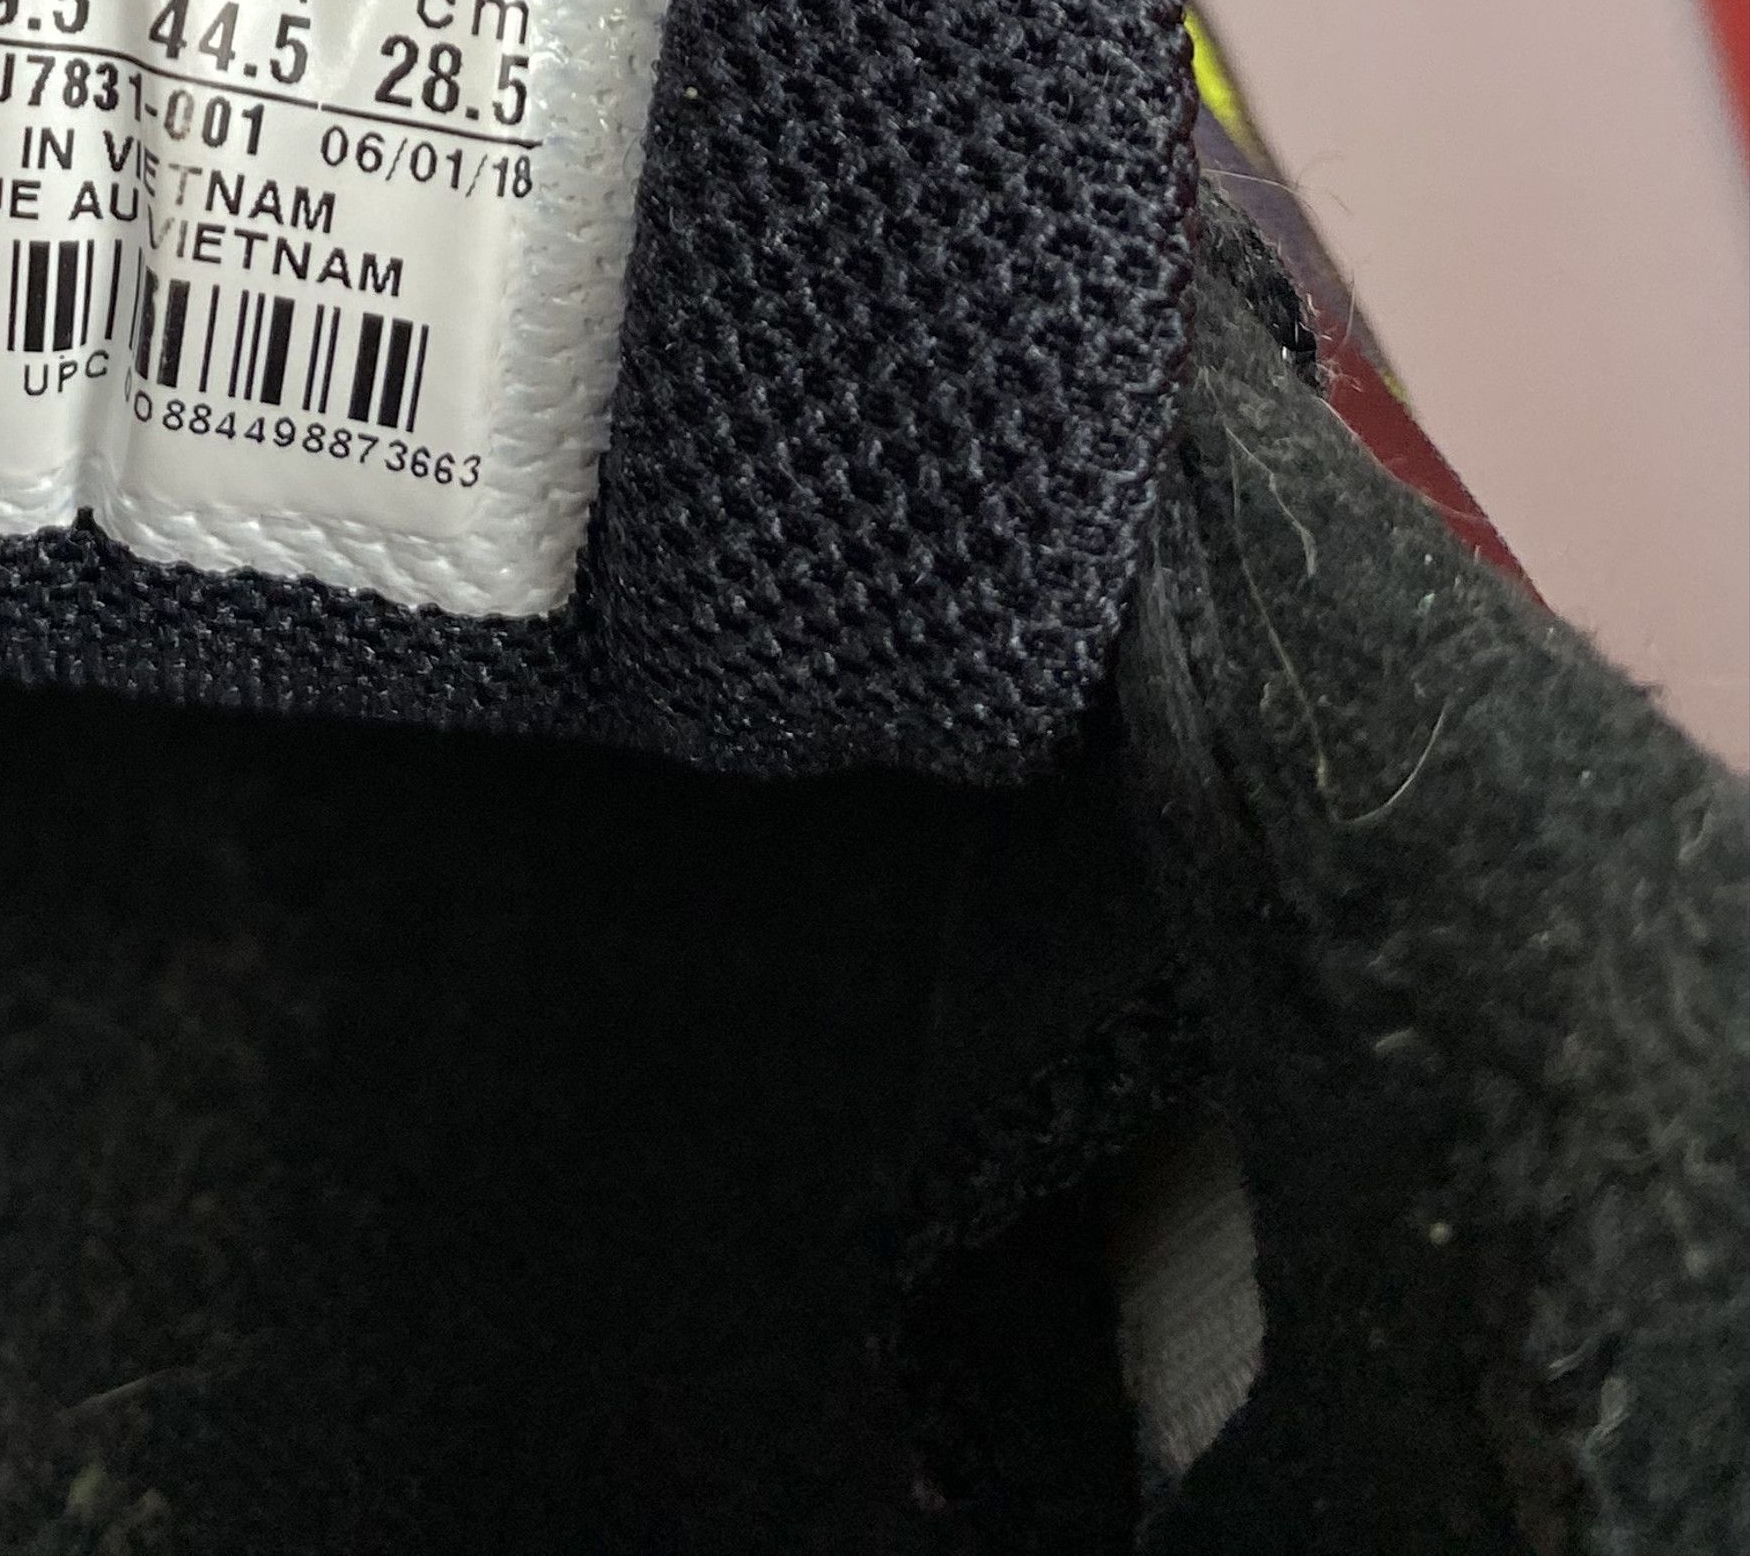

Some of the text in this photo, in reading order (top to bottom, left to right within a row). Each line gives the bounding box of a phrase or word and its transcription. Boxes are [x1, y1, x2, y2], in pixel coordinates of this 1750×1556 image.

[375, 34, 530, 126] 28.5
[21, 126, 74, 171] IN
[103, 130, 336, 234] VIETNAM
[321, 125, 532, 198] 06/01/18
[68, 181, 139, 223] AU
[148, 204, 404, 297] VIETNAM
[24, 350, 110, 397] UPC
